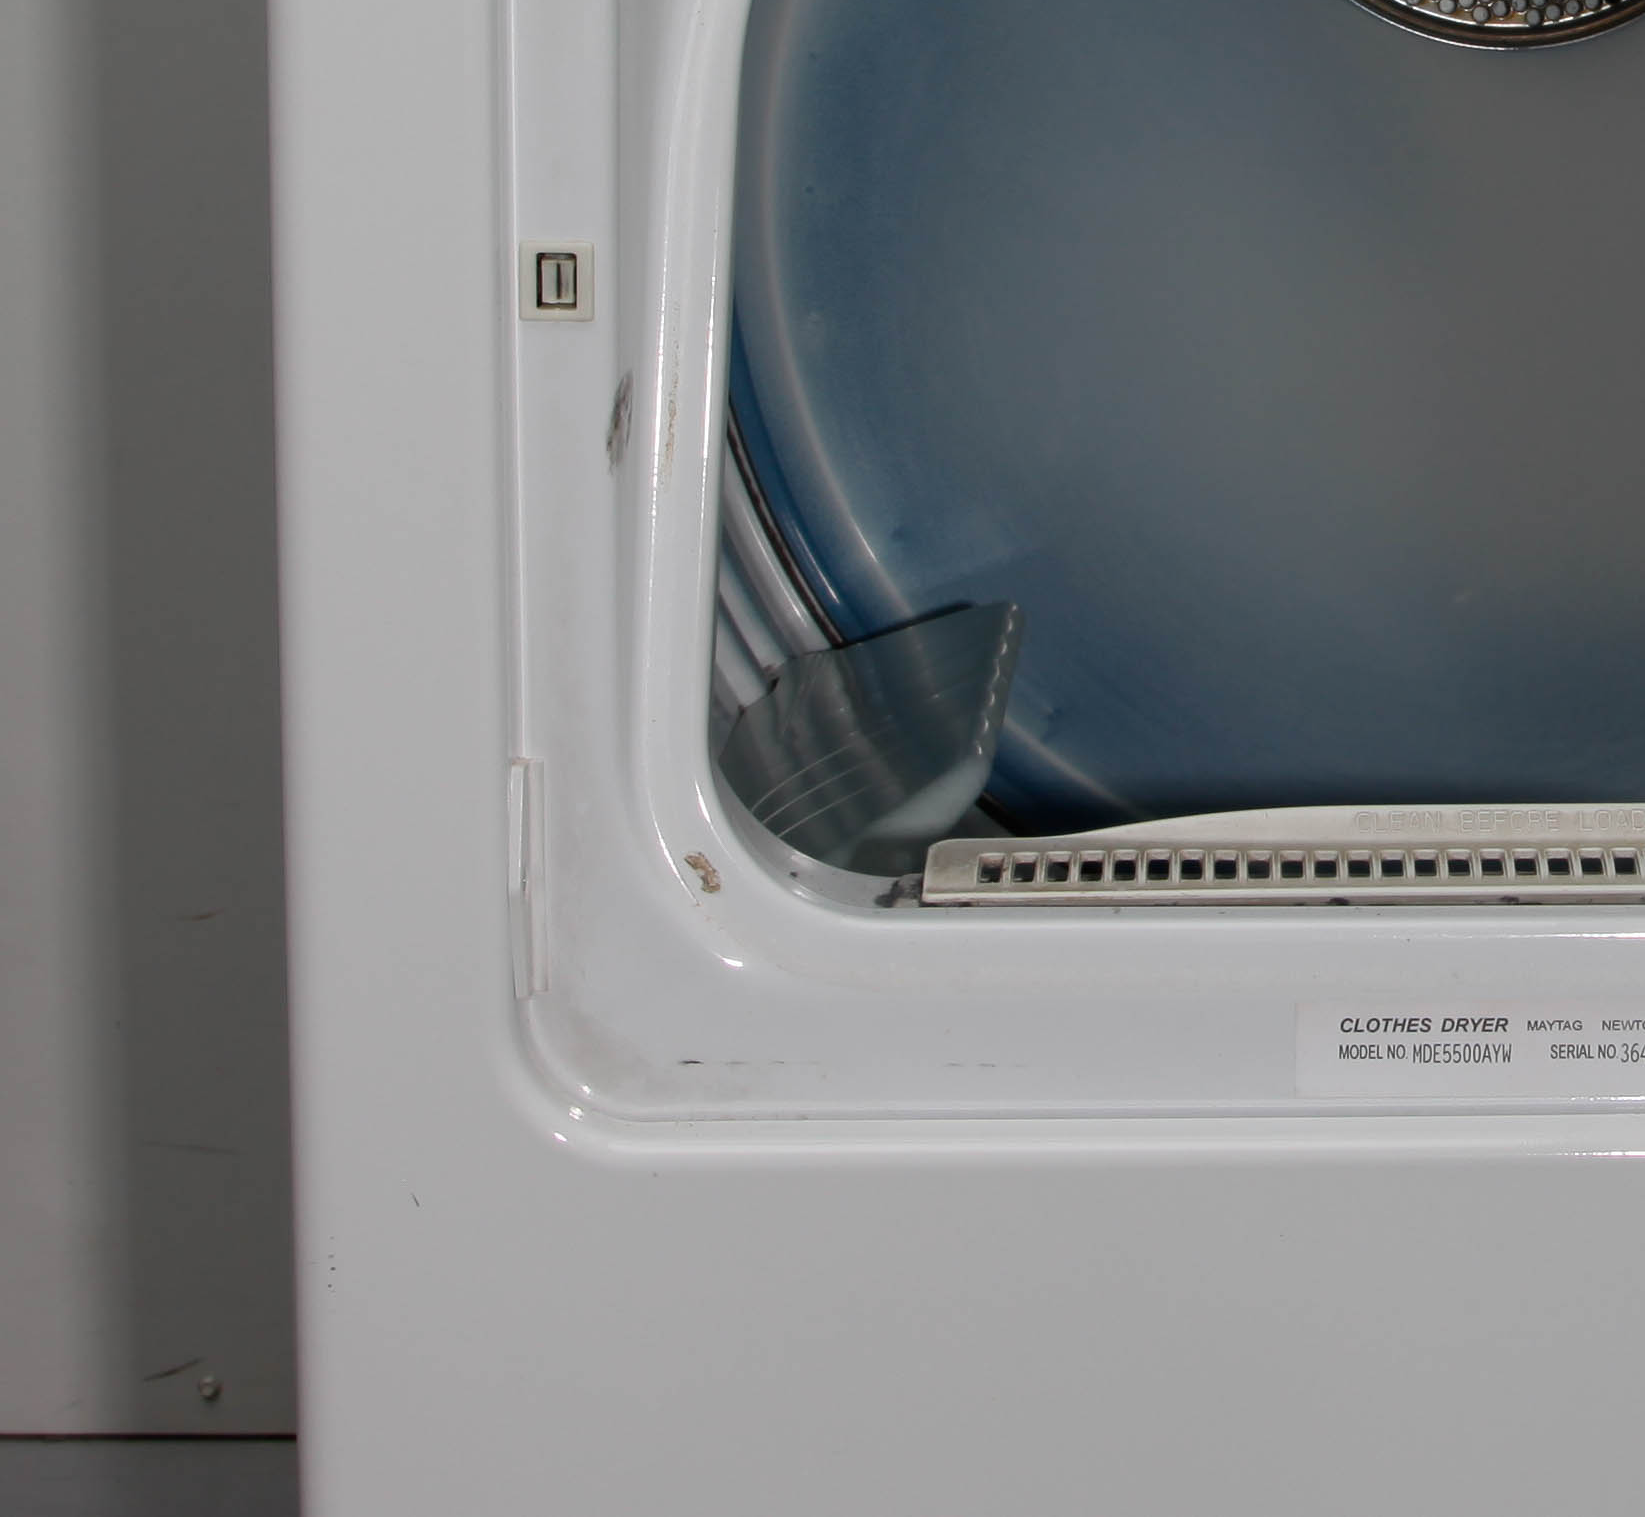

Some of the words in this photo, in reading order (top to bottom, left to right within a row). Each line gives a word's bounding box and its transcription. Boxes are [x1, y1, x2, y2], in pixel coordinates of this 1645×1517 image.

[1354, 809, 1442, 835] CLEAN
[1339, 1017, 1432, 1033] CLOTHES
[1441, 1017, 1509, 1033] DRYER
[1526, 1020, 1583, 1032] MAYTAG
[1338, 1044, 1383, 1060] MODEL
[1386, 1044, 1409, 1060] NO.
[1412, 1043, 1512, 1064] MDE5500AYW
[1550, 1044, 1595, 1060] SERIAL
[1597, 1044, 1619, 1060] NO.
